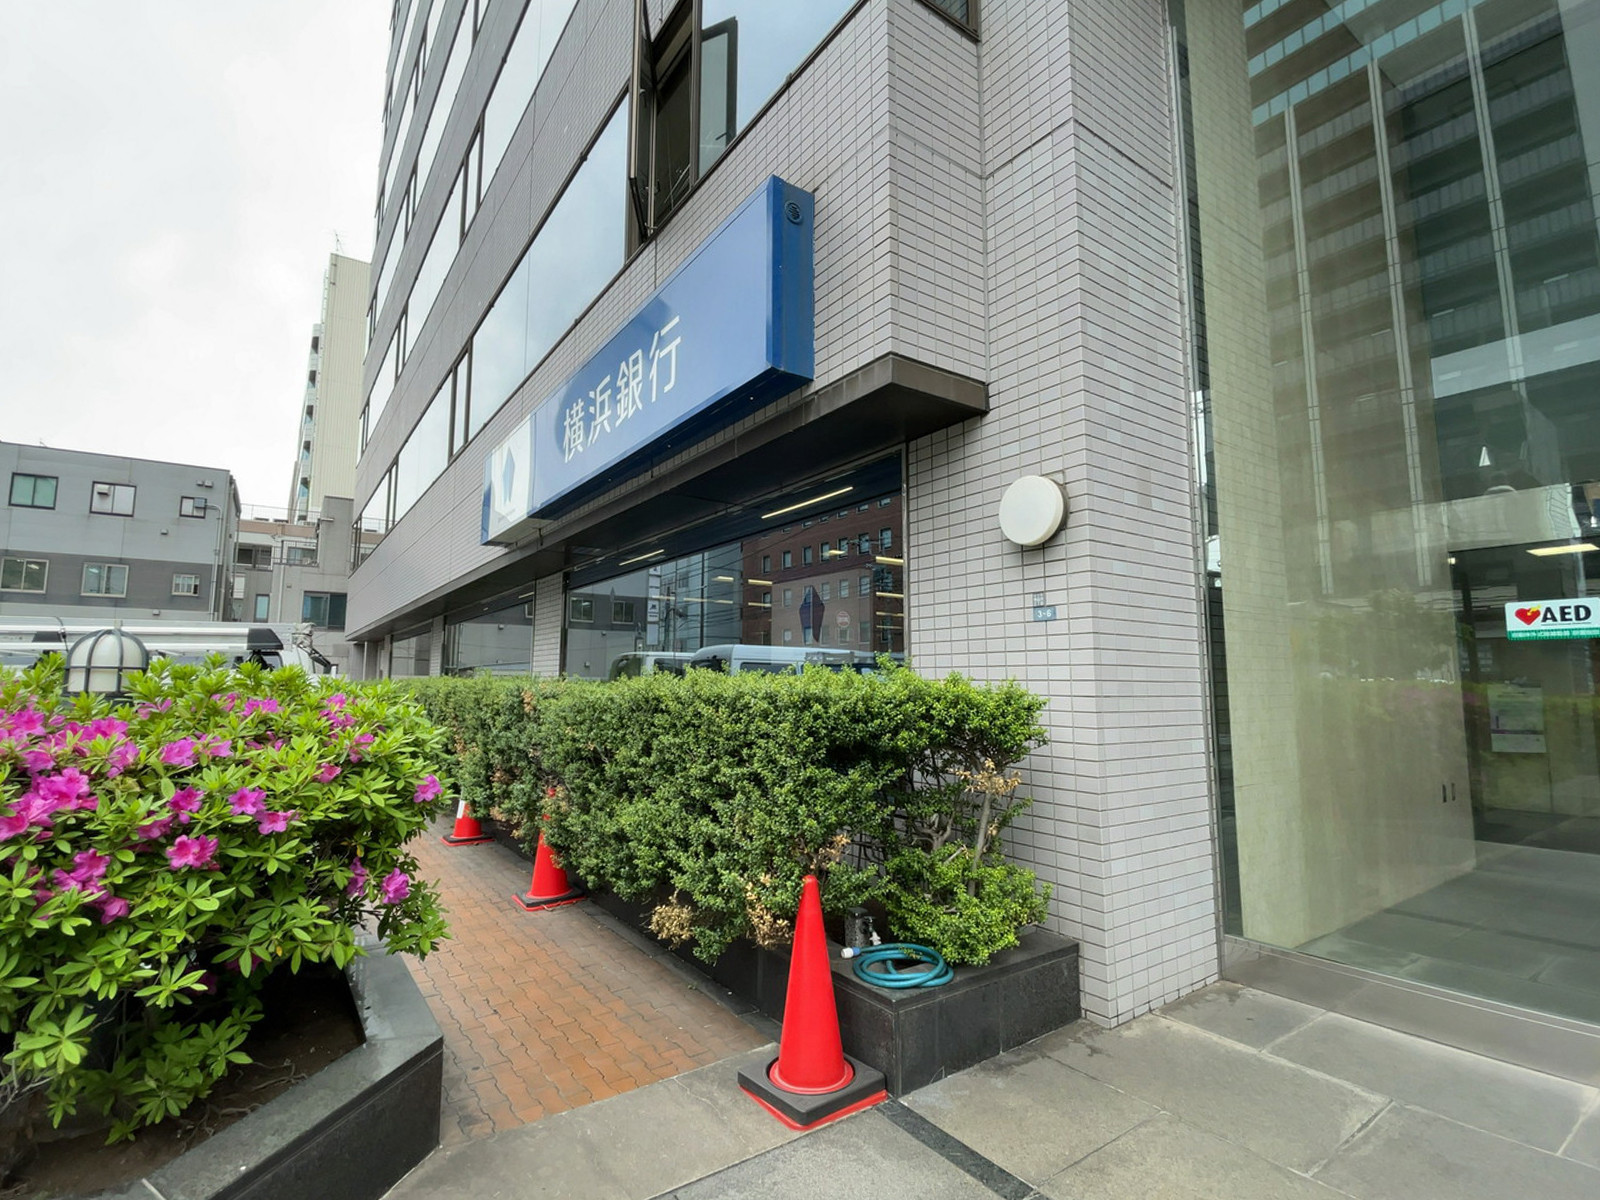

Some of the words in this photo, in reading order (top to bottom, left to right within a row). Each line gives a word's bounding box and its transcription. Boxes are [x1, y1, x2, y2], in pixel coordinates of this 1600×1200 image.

[563, 315, 682, 464] 横浜銀行
[1541, 605, 1592, 623] AED
